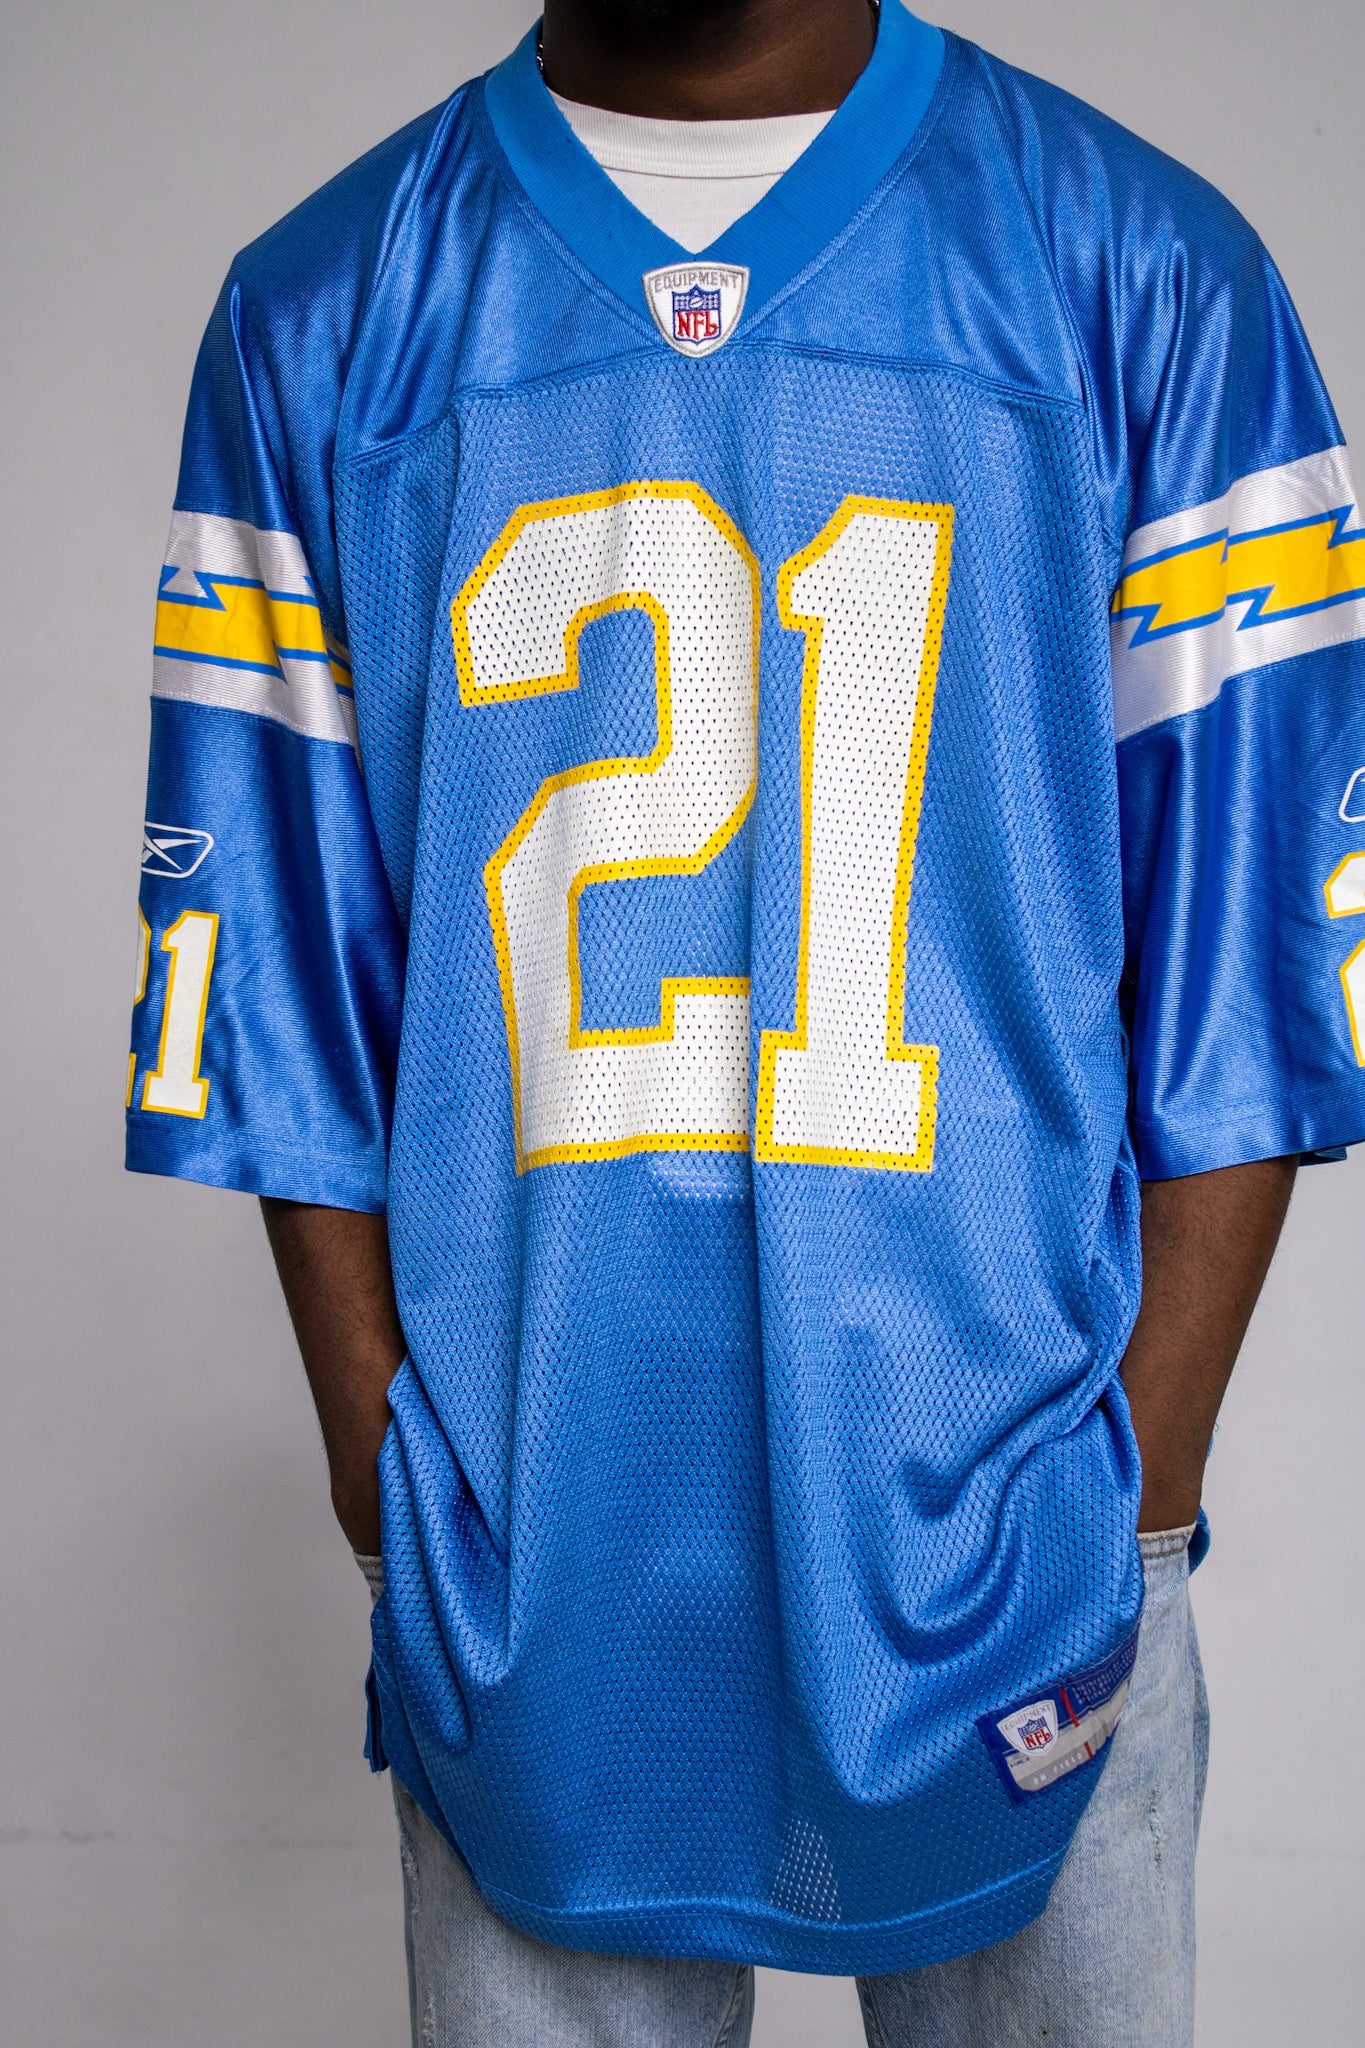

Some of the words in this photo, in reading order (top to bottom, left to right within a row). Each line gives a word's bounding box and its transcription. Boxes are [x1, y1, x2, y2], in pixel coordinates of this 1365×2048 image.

[654, 271, 738, 293] EQUIPMENT
[677, 311, 718, 340] NFL
[452, 480, 955, 1176] 21
[126, 903, 219, 1119] 1
[1004, 1703, 1051, 1731] EQUIPMENT
[1024, 1728, 1051, 1748] NFL
